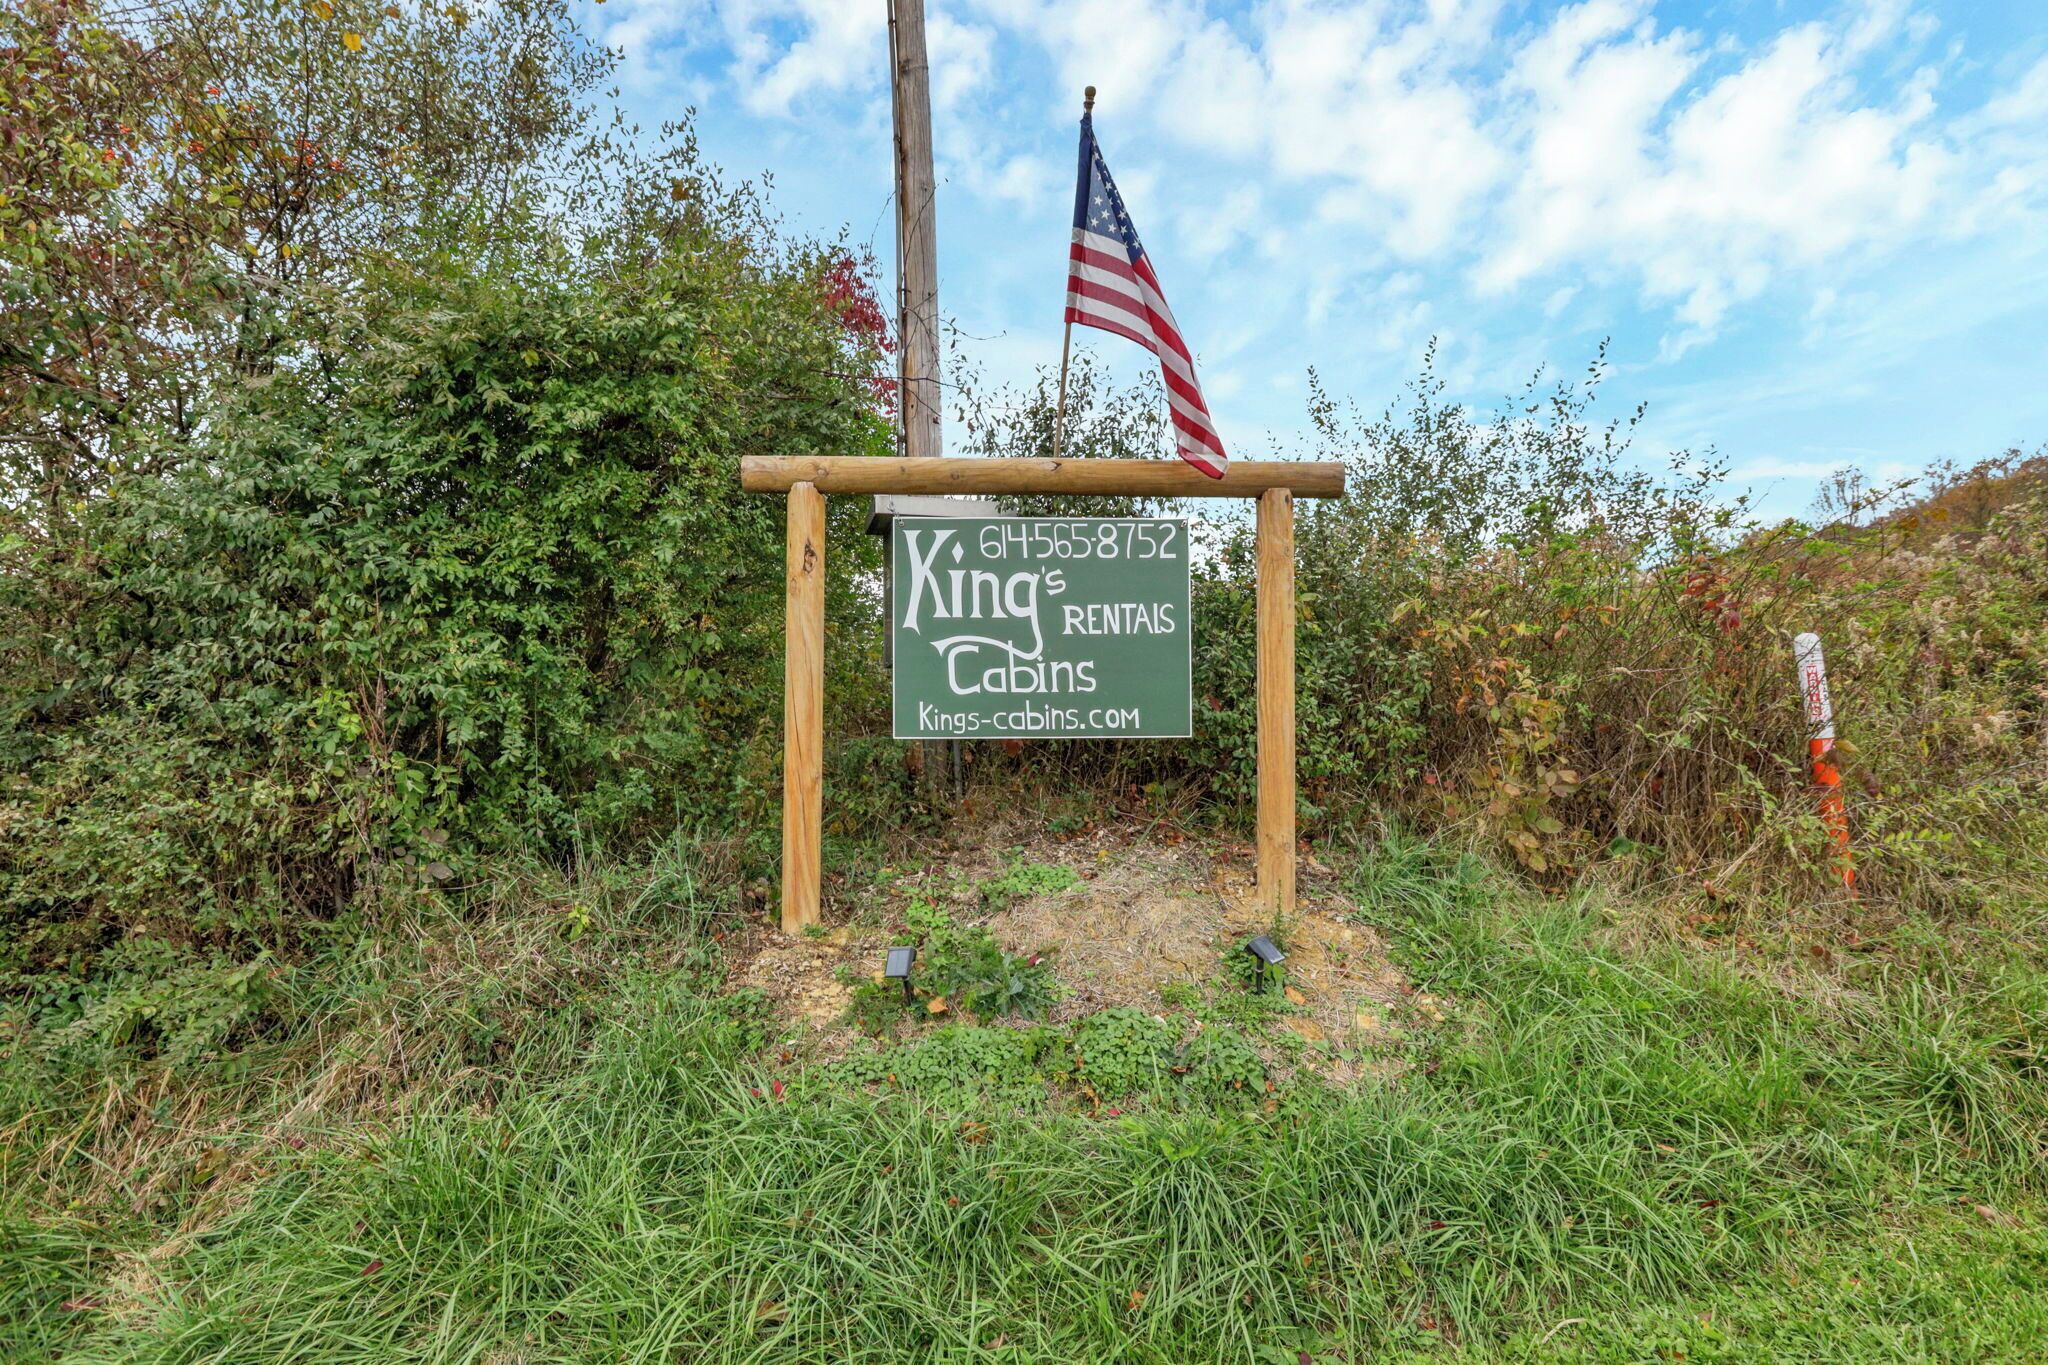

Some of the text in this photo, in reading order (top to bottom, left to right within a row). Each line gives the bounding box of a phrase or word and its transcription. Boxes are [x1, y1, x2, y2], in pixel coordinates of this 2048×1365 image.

[980, 523, 1177, 559] 614-565-8752
[902, 529, 1067, 660] King's
[1061, 603, 1176, 635] RENTALS
[947, 640, 1097, 695] Cabins
